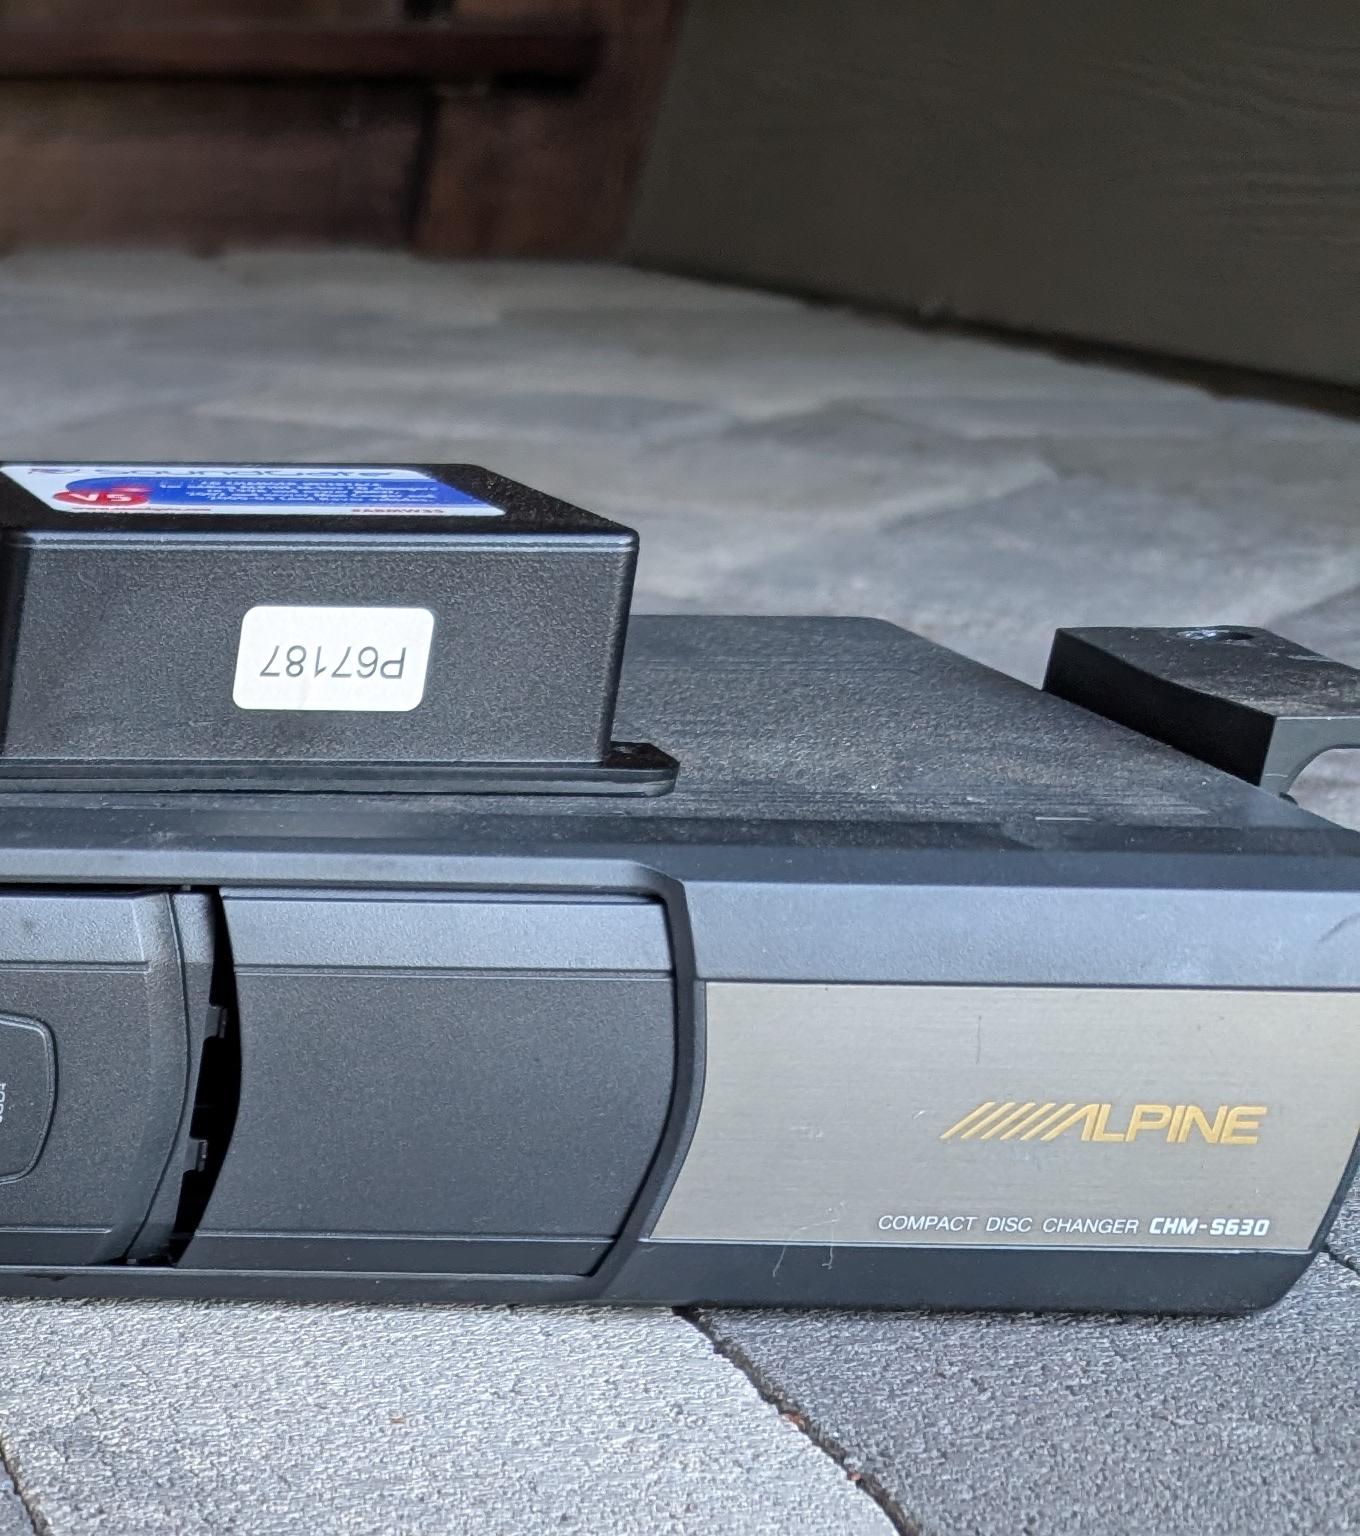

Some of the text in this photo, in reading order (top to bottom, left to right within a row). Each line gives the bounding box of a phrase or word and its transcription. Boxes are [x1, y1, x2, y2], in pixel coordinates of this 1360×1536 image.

[259, 645, 407, 679] P67187
[1043, 1103, 1268, 1144] ALPINE
[877, 1213, 1271, 1237] COMPACT DISC CHANGER CHM-S630
